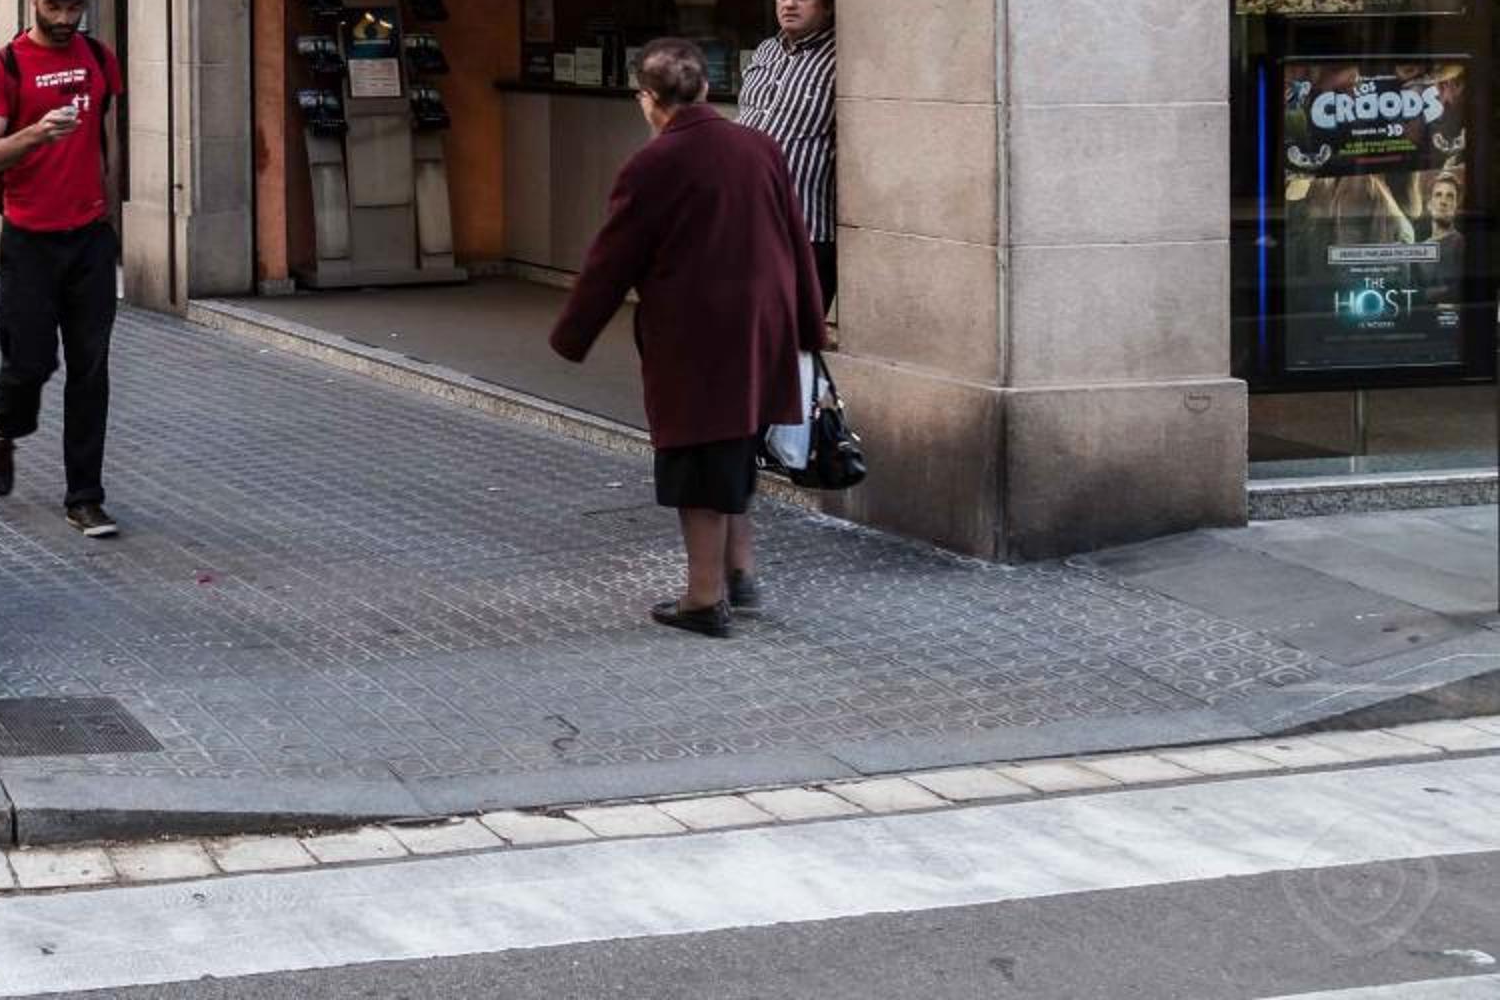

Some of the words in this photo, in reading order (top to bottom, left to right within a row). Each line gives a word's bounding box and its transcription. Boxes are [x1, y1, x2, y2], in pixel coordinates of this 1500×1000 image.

[1311, 86, 1444, 129] CROODS
[1364, 277, 1385, 289] THE
[1334, 289, 1419, 317] HOST
